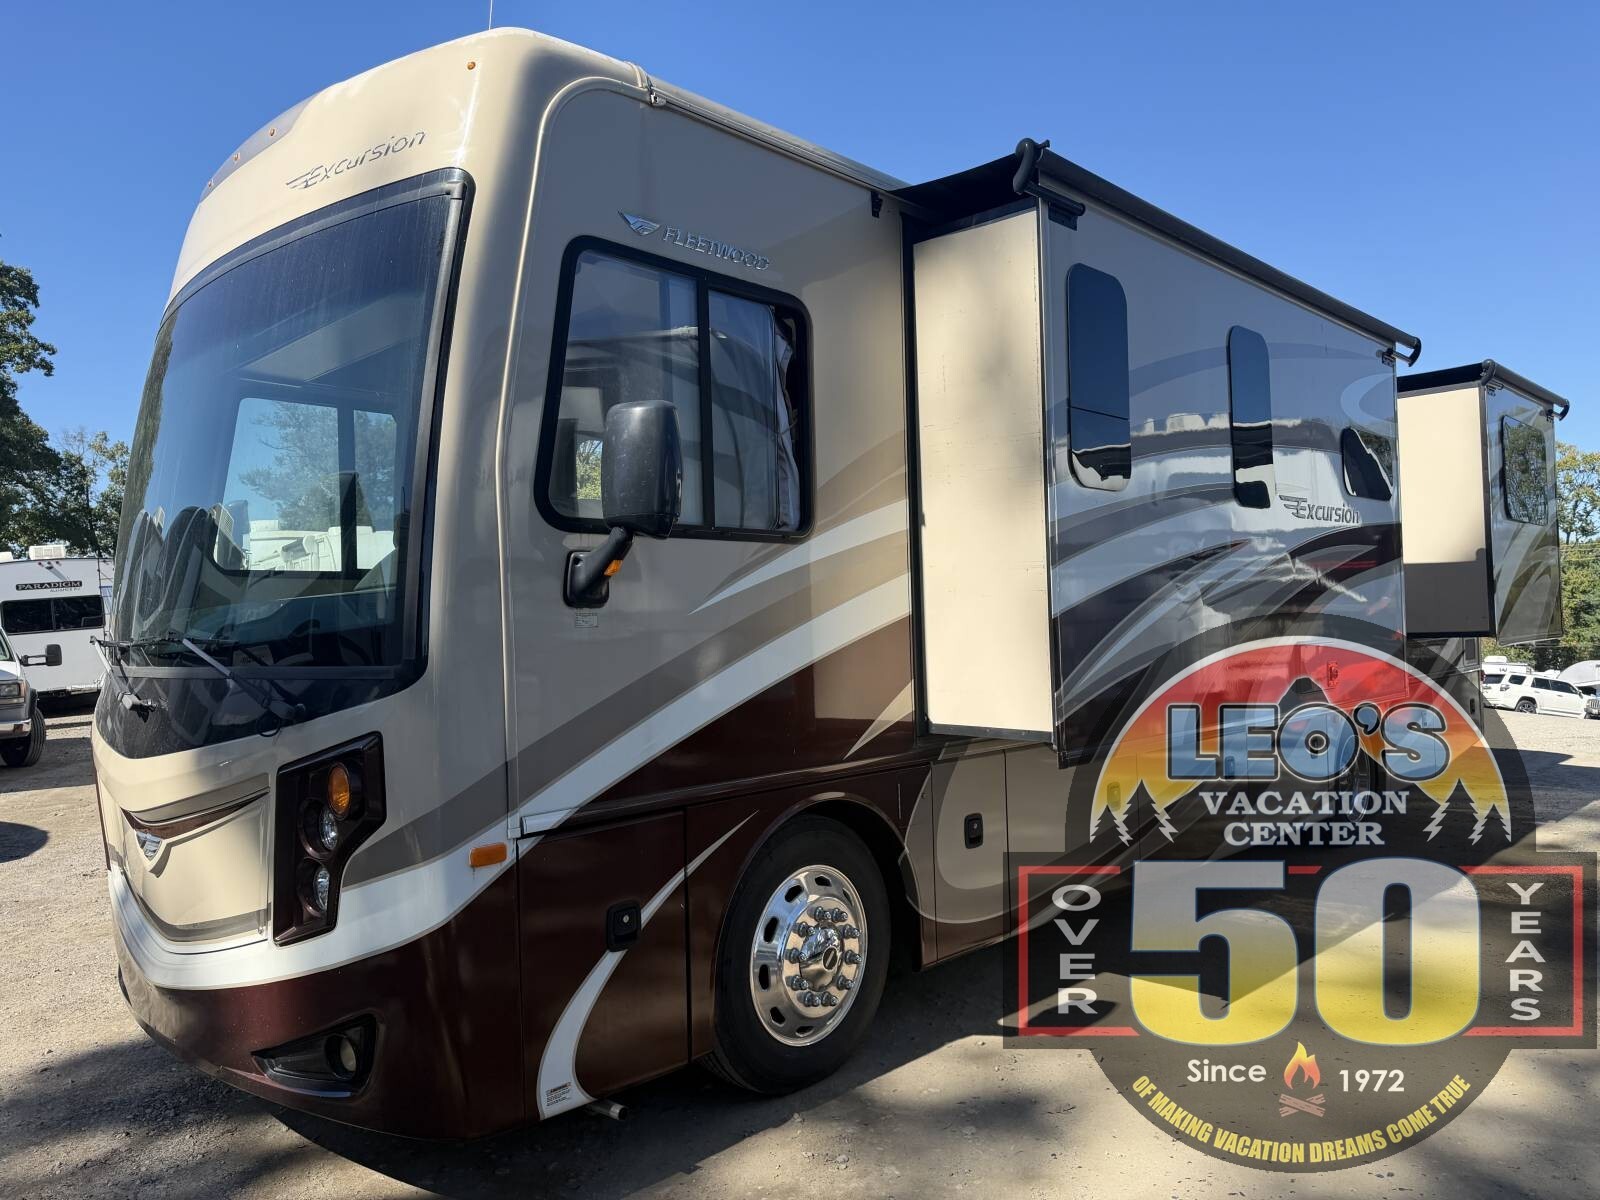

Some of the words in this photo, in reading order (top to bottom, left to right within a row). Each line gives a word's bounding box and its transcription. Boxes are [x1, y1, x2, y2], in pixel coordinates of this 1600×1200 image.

[663, 227, 769, 270] FLEETWOOD
[1279, 495, 1359, 523] Excursion
[17, 581, 80, 590] PARADIGM
